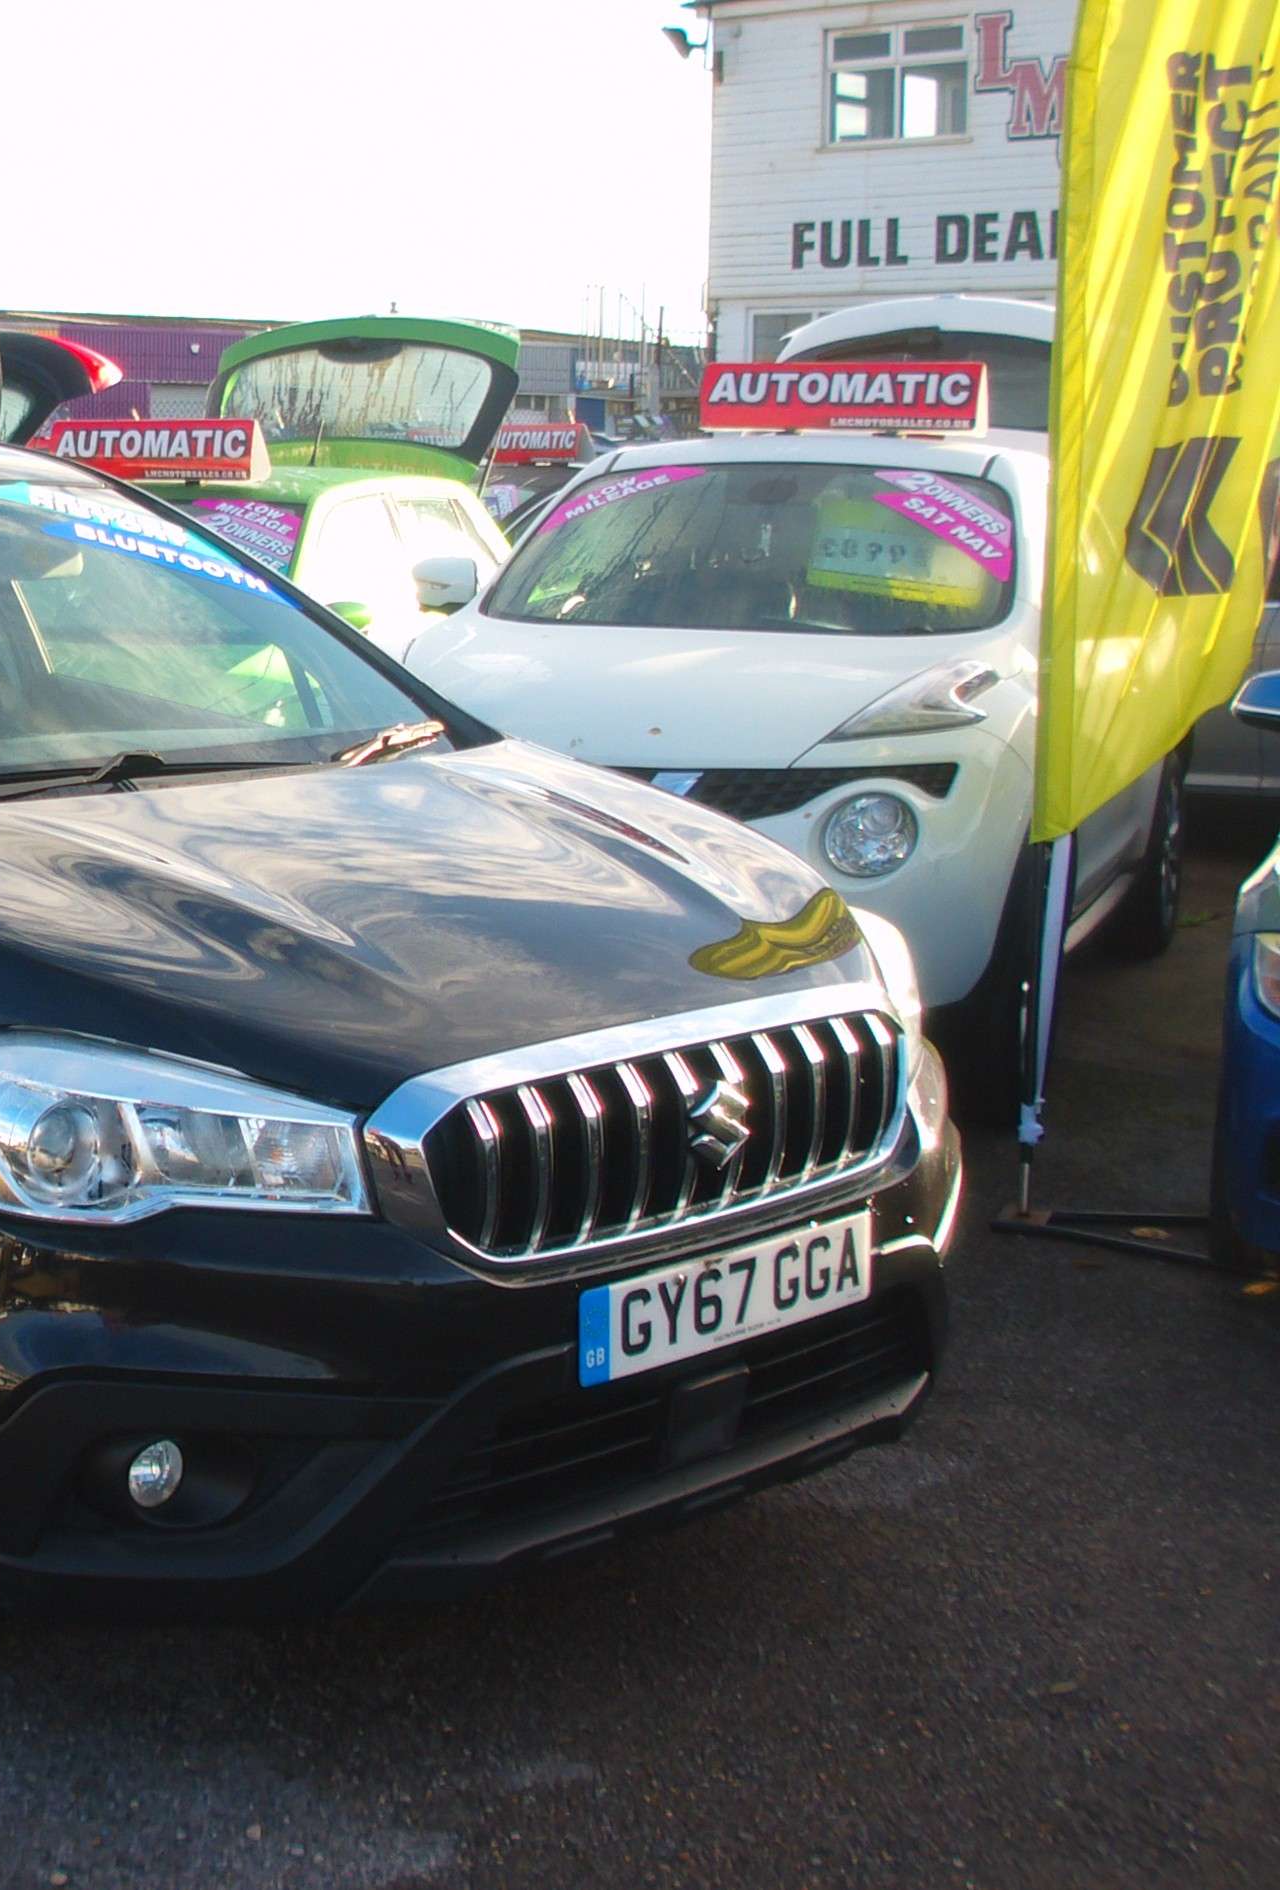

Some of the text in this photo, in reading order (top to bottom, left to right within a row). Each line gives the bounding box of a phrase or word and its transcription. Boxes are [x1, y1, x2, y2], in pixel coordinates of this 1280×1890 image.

[974, 11, 1070, 141] LM
[791, 209, 1060, 270] FULL DEA
[708, 372, 973, 406] AUTOMATIC
[56, 429, 247, 460] AUTOMATIC
[564, 474, 671, 519] MILEAGE
[588, 476, 637, 501] LOW
[215, 502, 293, 536] MILEAGE
[244, 502, 285, 519] LOW
[903, 498, 1004, 560] SAT NAV
[923, 483, 1007, 536] OWNERS
[73, 522, 270, 594] BLUETOOTH
[223, 522, 293, 556] OWNERS
[620, 1227, 860, 1358] GY67 GGA
[585, 1347, 605, 1369] GB
